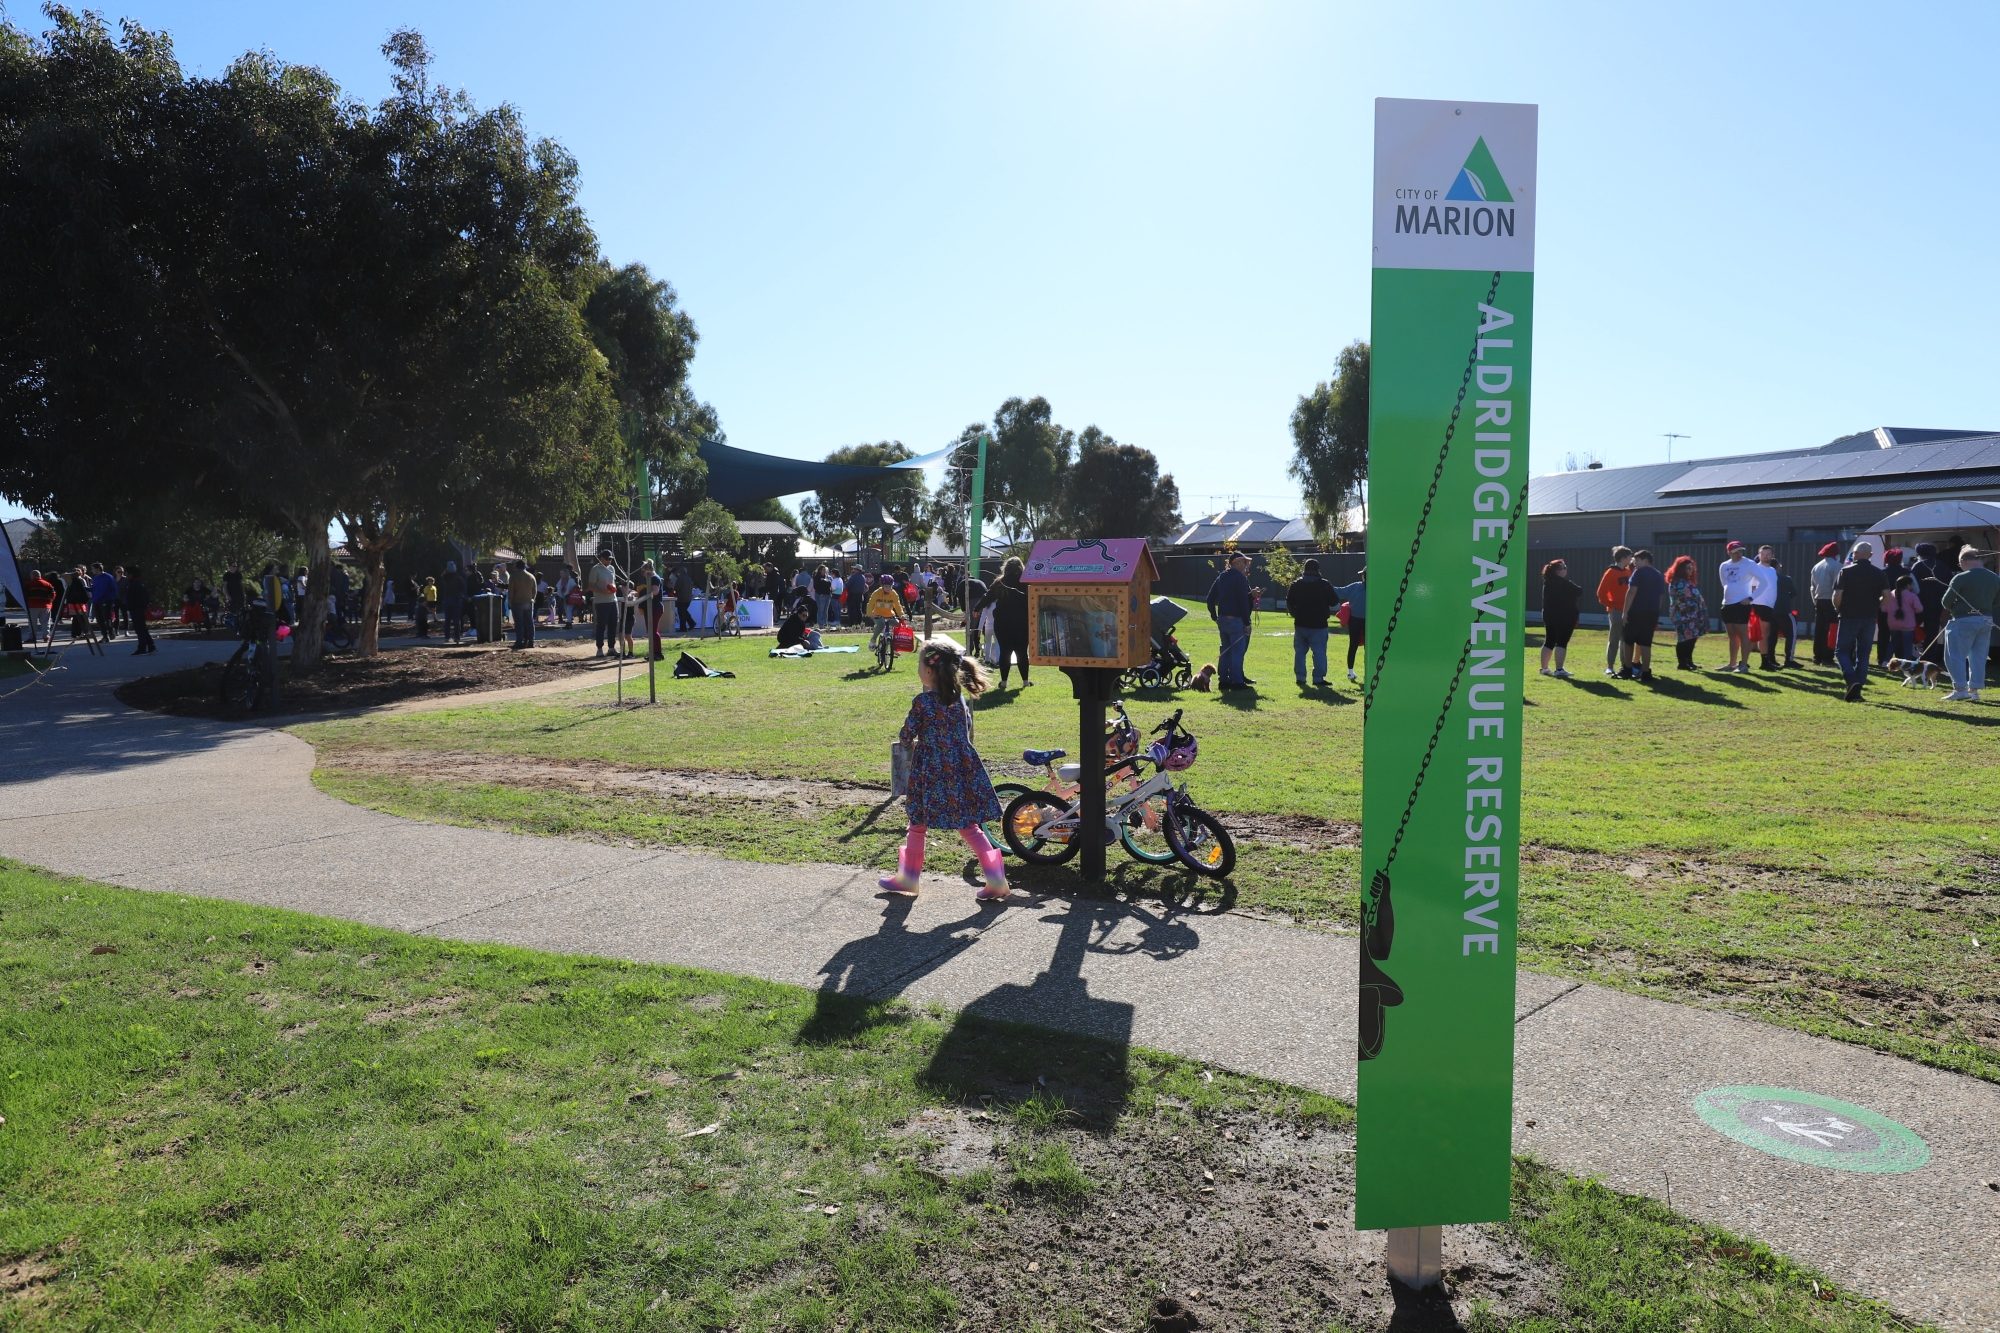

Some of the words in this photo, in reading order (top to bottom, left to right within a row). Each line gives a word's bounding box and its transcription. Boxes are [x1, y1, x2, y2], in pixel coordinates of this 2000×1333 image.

[1395, 188, 1421, 200] CITY
[1424, 189, 1439, 200] OF
[1395, 204, 1515, 237] MARION
[1472, 301, 1514, 542] ALDRIDGE
[1467, 555, 1508, 741] AVENUE
[1462, 756, 1504, 957] RESERVE
